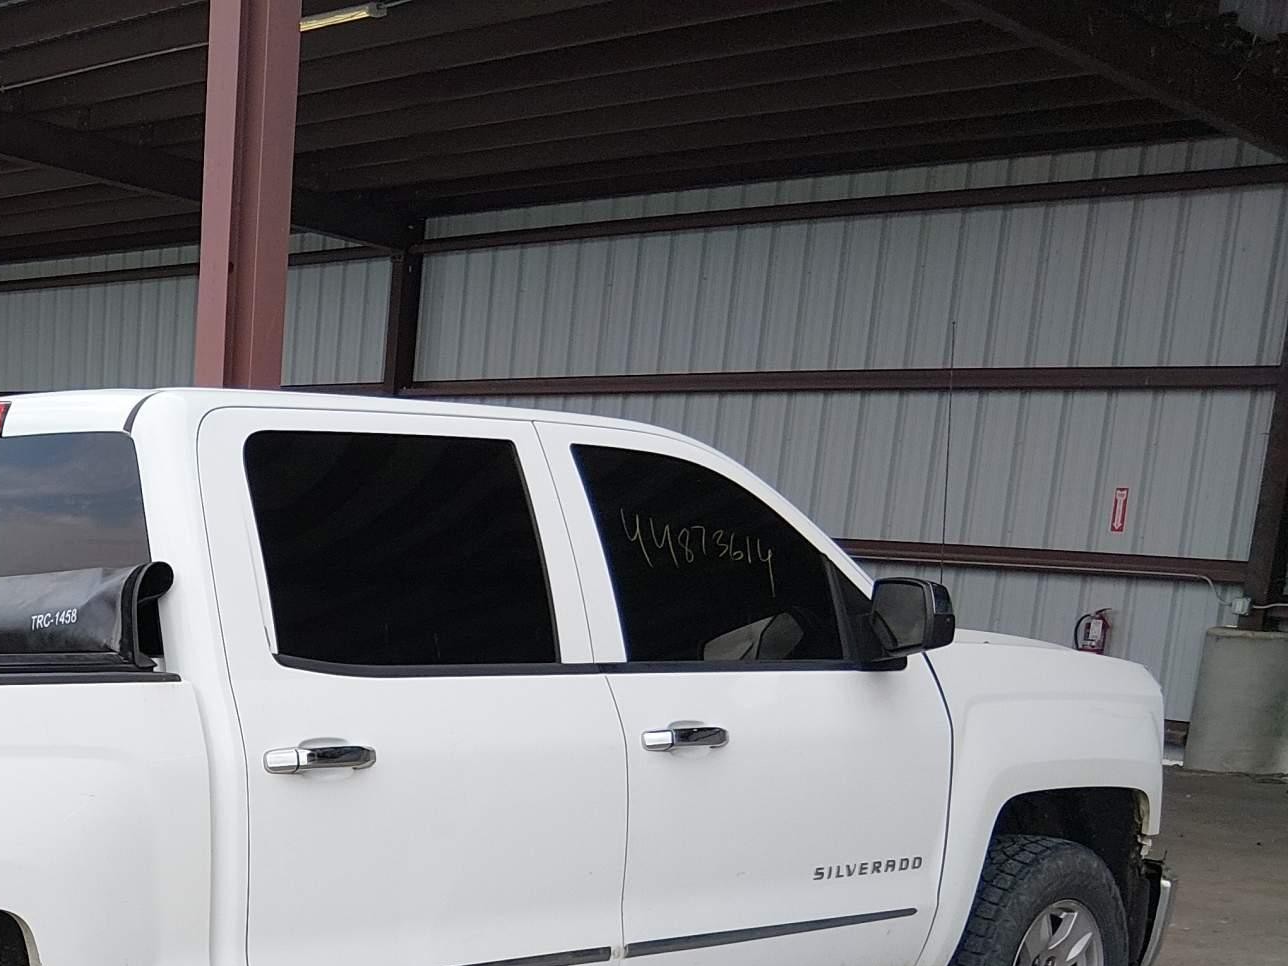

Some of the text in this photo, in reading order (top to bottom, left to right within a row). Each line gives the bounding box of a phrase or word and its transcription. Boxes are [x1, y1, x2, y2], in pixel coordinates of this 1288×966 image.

[620, 507, 776, 598] 44873614
[31, 608, 78, 631] TRC-1458
[812, 856, 924, 881] SILVERADO
